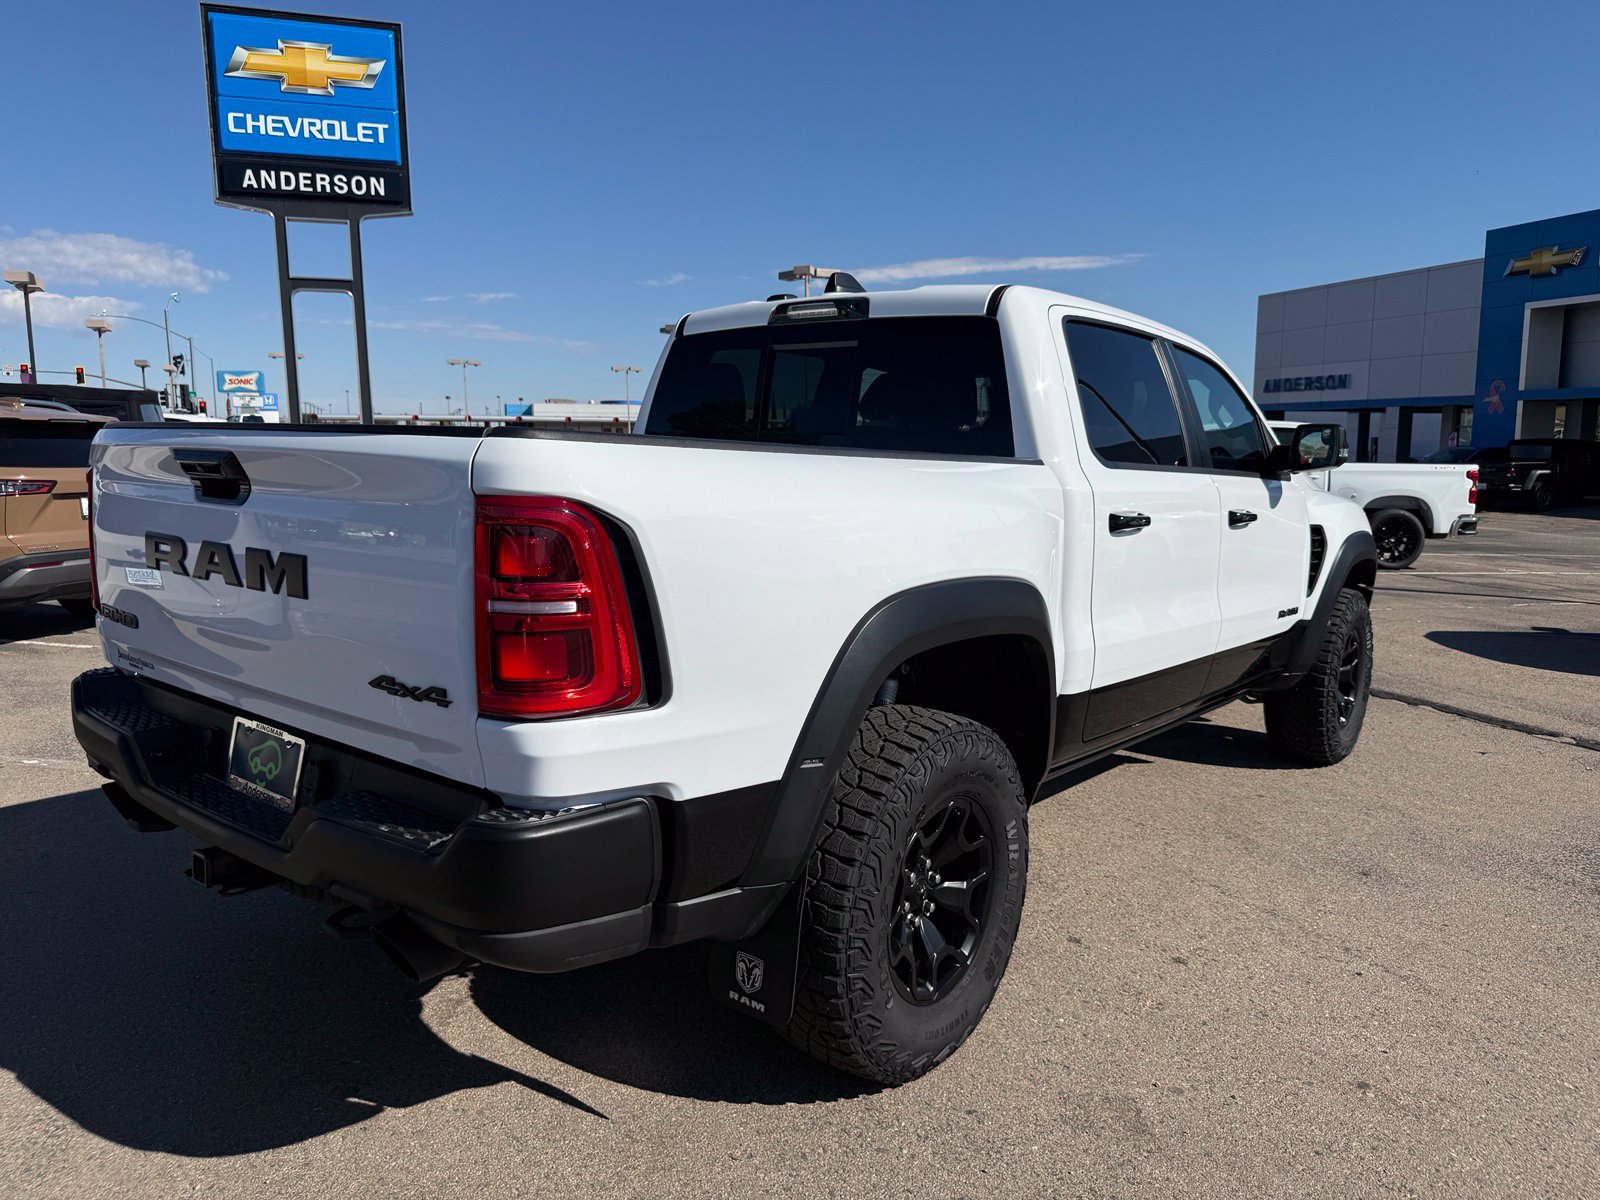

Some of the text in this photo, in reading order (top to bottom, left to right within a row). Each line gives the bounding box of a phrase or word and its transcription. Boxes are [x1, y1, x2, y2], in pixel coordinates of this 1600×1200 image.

[227, 112, 389, 144] CHEVROLET
[242, 168, 386, 197] ANDERSON
[227, 378, 254, 386] SONIC
[1262, 374, 1351, 393] ANDERSON
[144, 530, 309, 601] RAM
[255, 722, 284, 738] KINGMAN
[728, 990, 765, 1013] RAM
